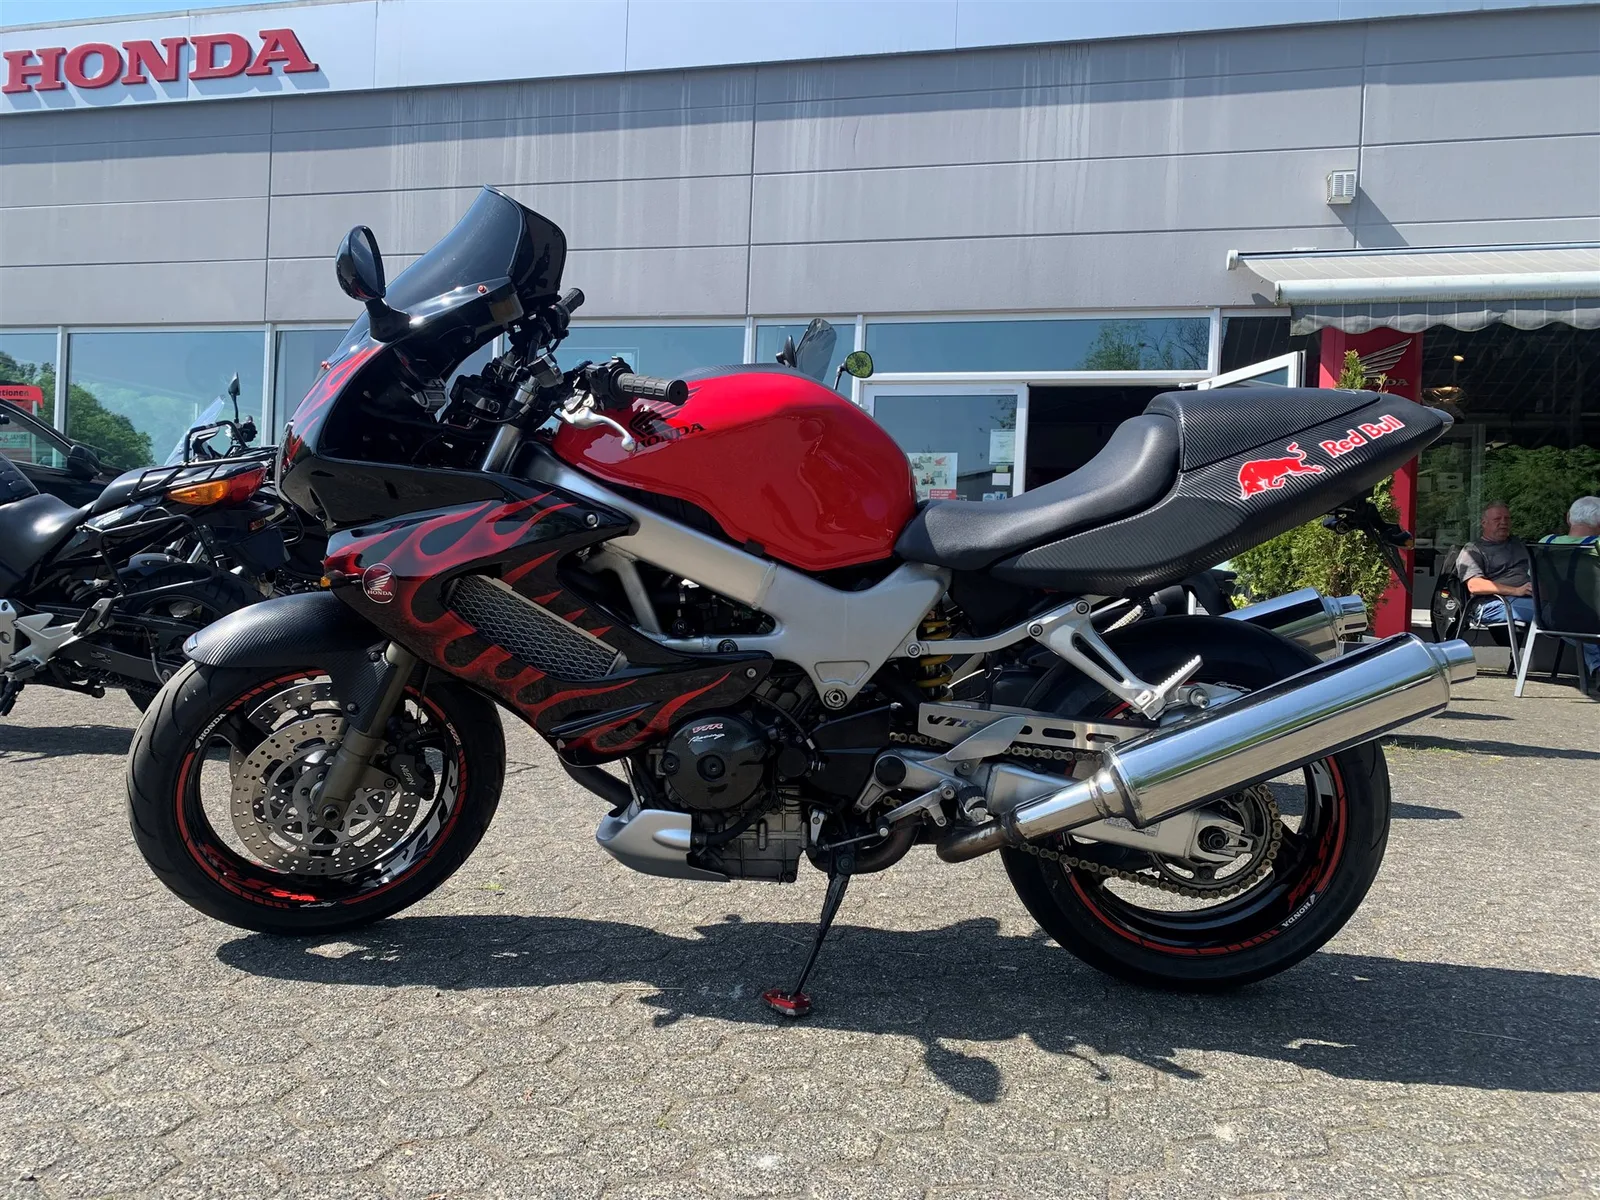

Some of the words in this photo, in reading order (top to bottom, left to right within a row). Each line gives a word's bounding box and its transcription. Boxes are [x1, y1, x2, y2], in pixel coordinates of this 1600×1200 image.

[3, 28, 319, 94] HONDA
[0, 389, 30, 397] tionen
[1319, 429, 1369, 458] Red
[1358, 414, 1405, 440] Bull
[198, 713, 227, 741] HONDA
[1281, 901, 1312, 928] HONDA
